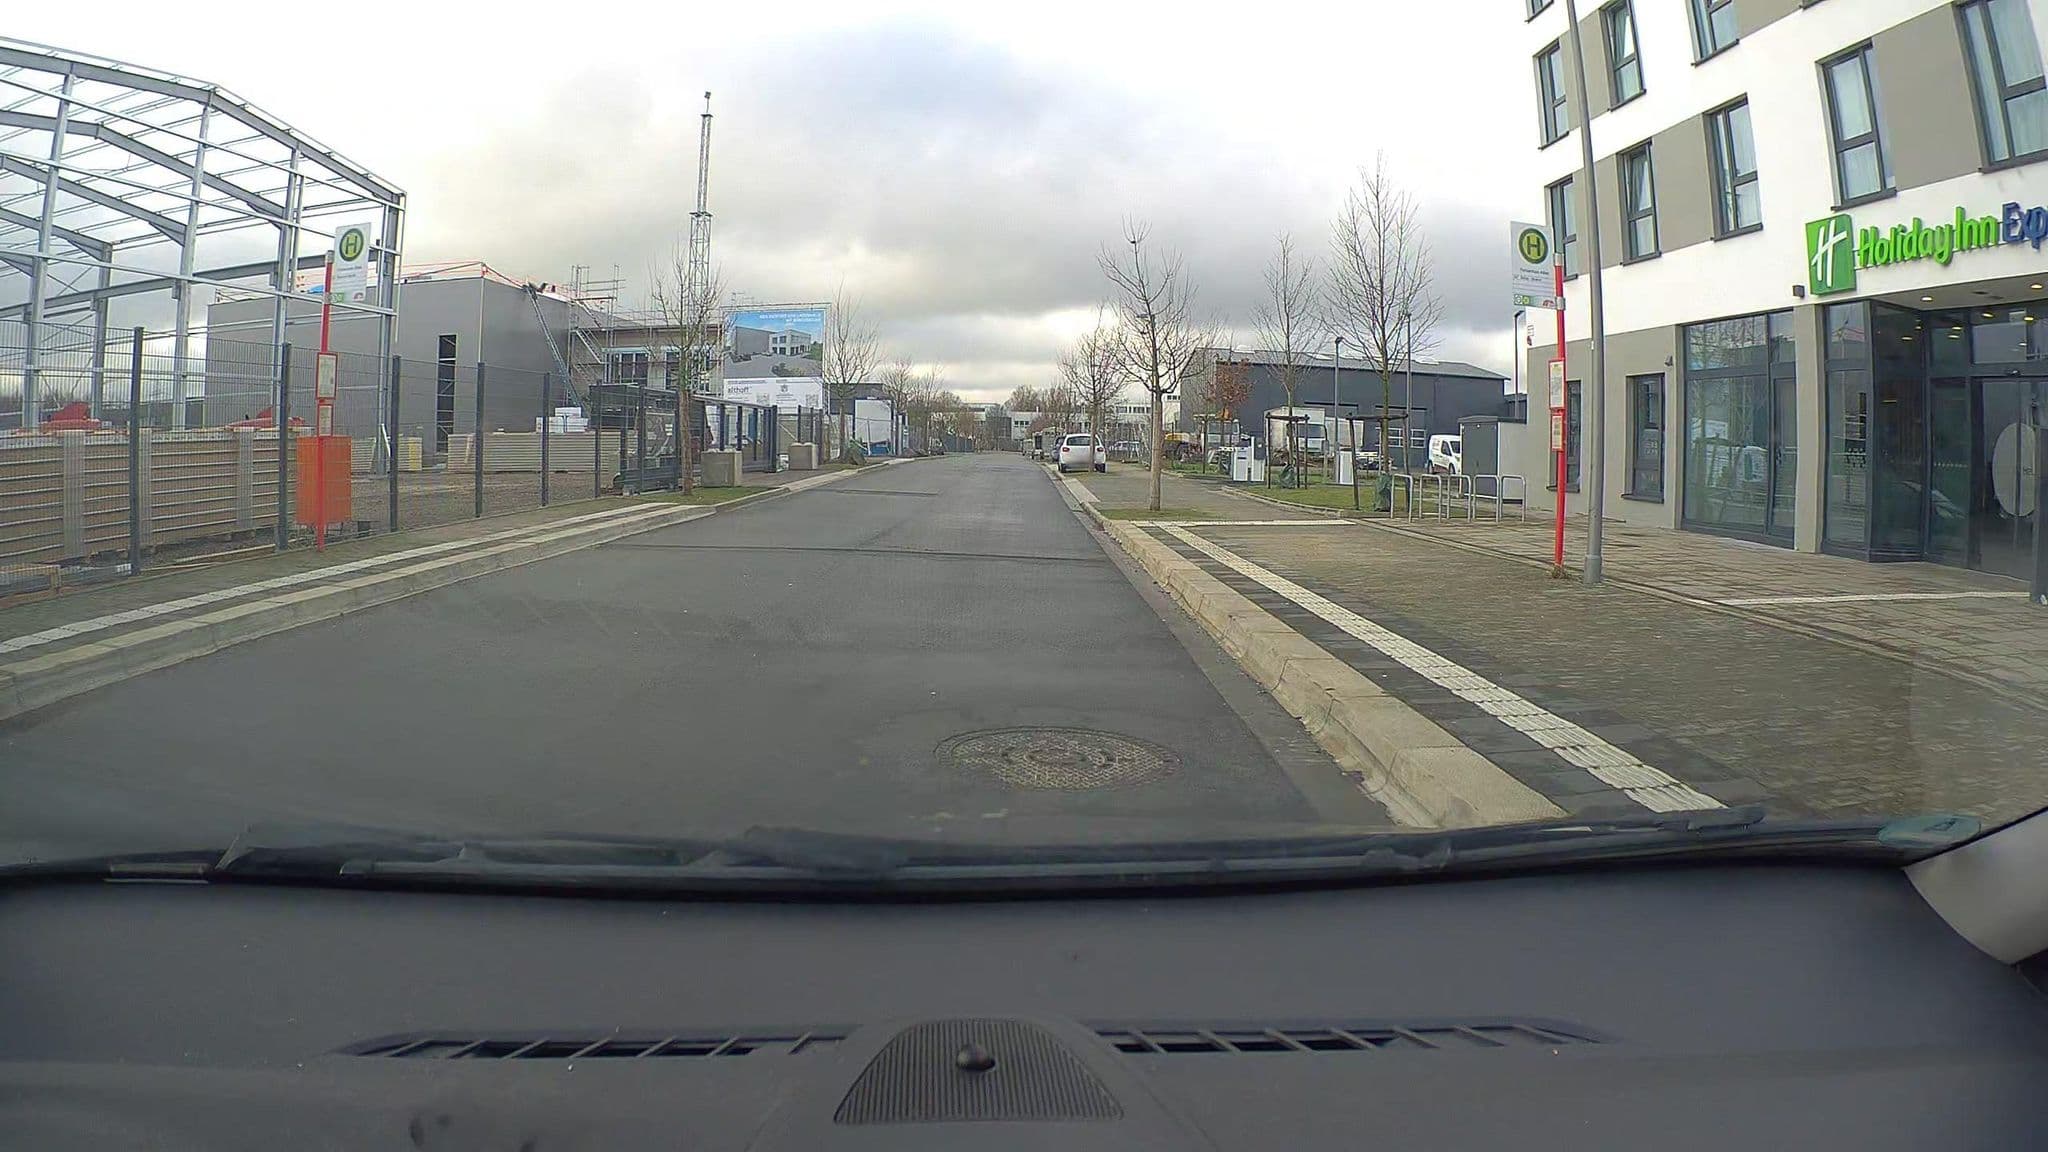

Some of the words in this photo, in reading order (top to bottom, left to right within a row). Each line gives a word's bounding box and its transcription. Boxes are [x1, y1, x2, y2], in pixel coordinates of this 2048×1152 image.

[345, 235, 358, 255] H
[1526, 235, 1541, 257] H
[1857, 216, 1953, 267] Holiday
[1954, 205, 1999, 250] Inn
